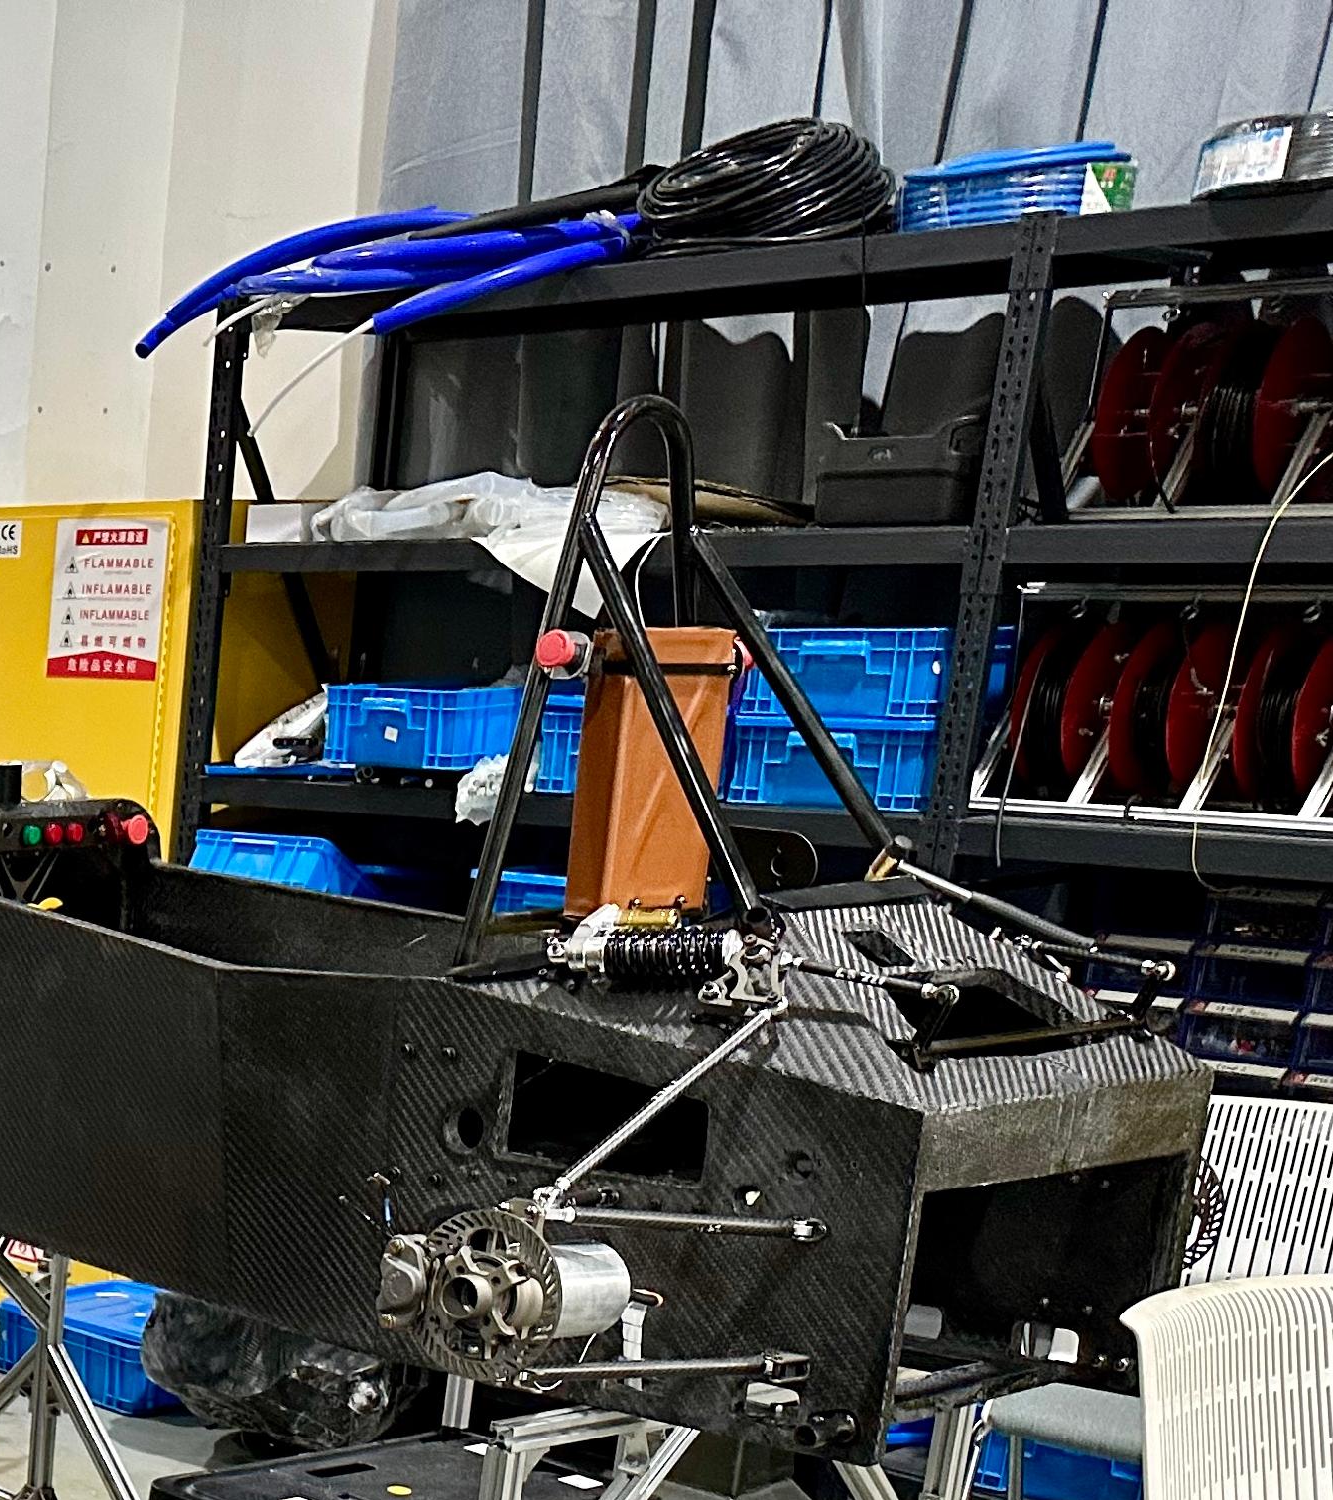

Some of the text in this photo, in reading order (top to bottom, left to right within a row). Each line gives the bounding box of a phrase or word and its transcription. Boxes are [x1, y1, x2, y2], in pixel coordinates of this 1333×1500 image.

[84, 558, 154, 569] FLAMMABLE
[82, 584, 152, 595] INFLAMABLE
[79, 609, 150, 621] INFLAMMABLE
